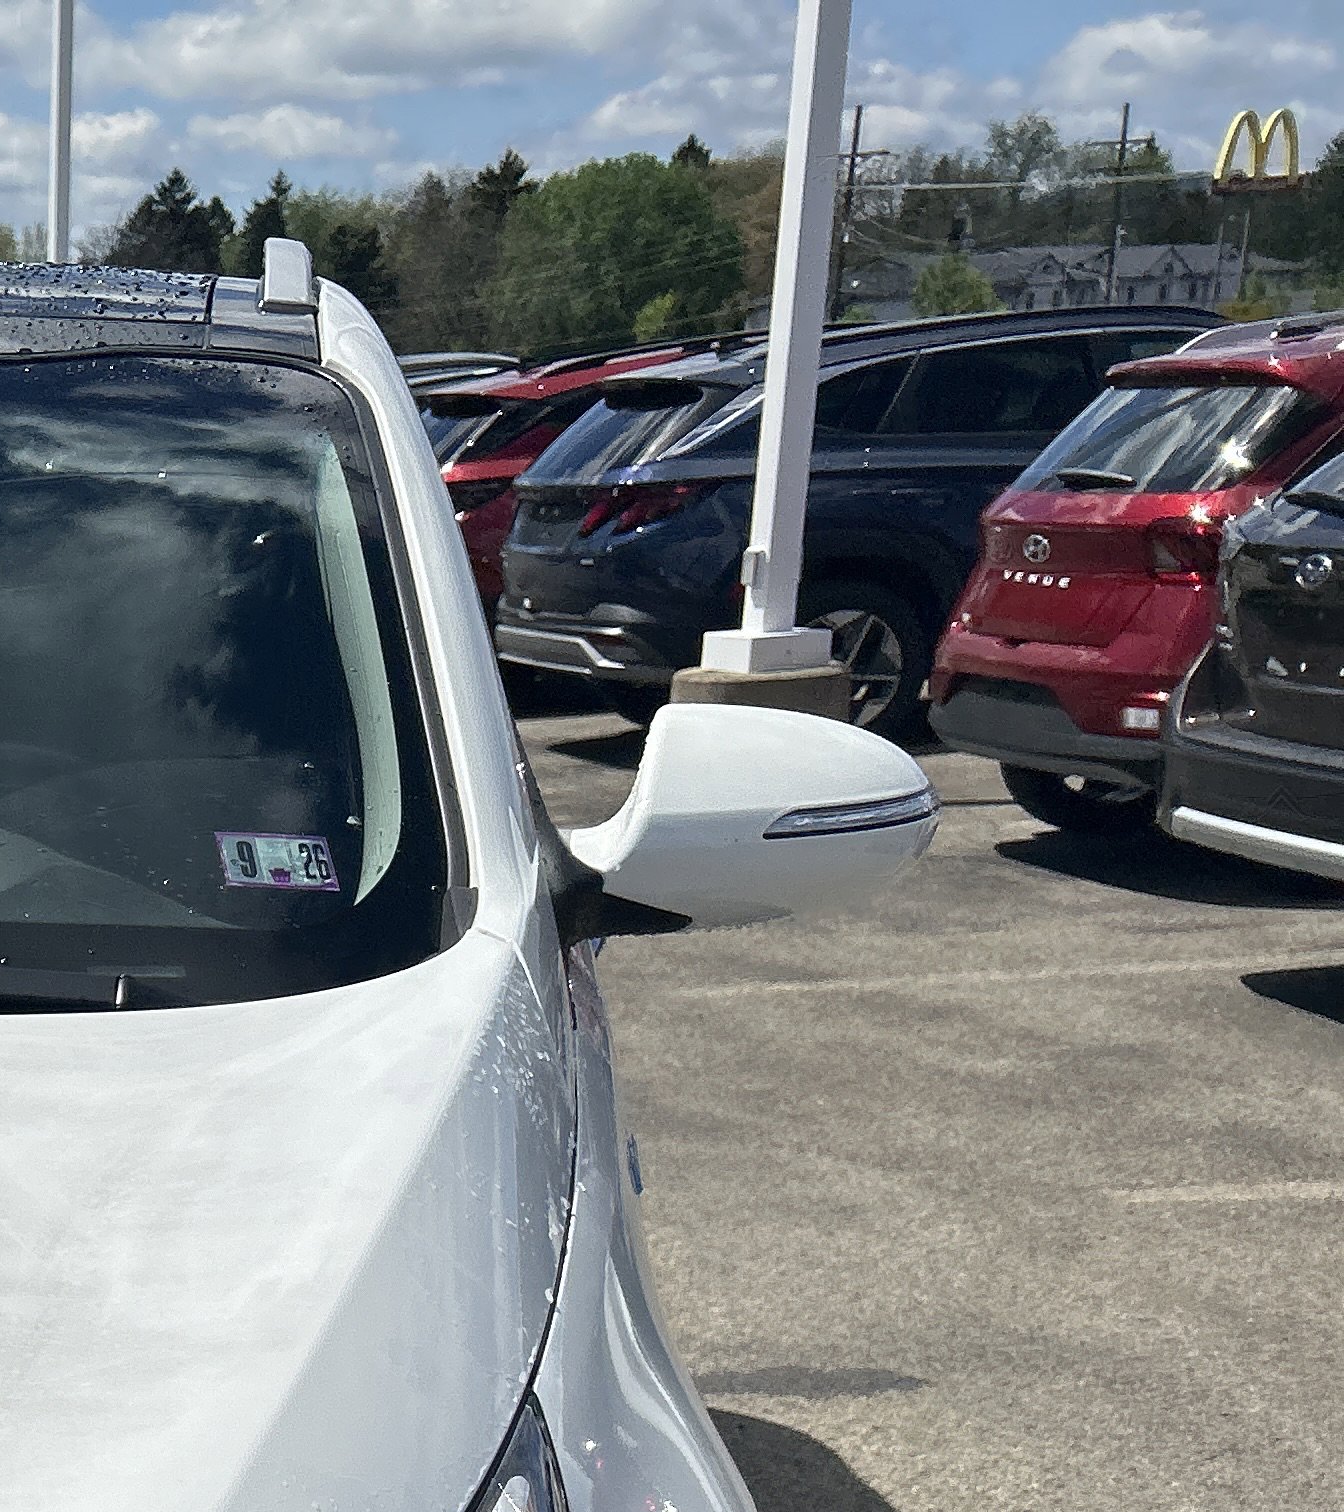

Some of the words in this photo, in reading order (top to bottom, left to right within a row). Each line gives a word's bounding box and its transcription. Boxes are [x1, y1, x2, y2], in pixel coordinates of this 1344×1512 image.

[1003, 569, 1071, 589] VENUE
[236, 841, 258, 878] 9
[298, 843, 332, 880] 26
